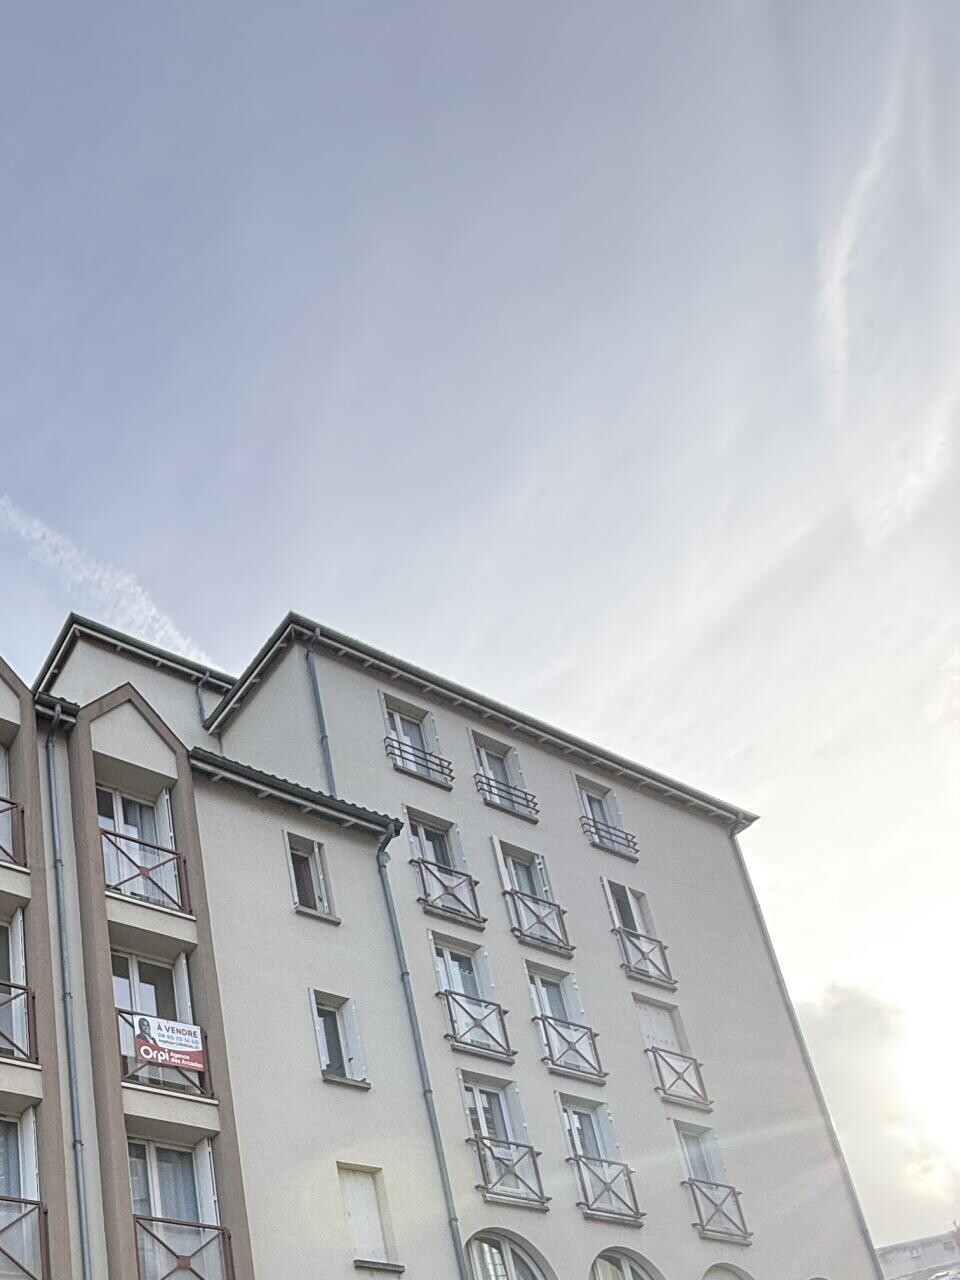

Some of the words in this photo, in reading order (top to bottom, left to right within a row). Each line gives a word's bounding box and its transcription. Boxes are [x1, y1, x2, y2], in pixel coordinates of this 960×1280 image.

[164, 1025, 198, 1038] VENDRE
[140, 1045, 170, 1063] Orpi
[182, 1059, 203, 1068] Arcades
